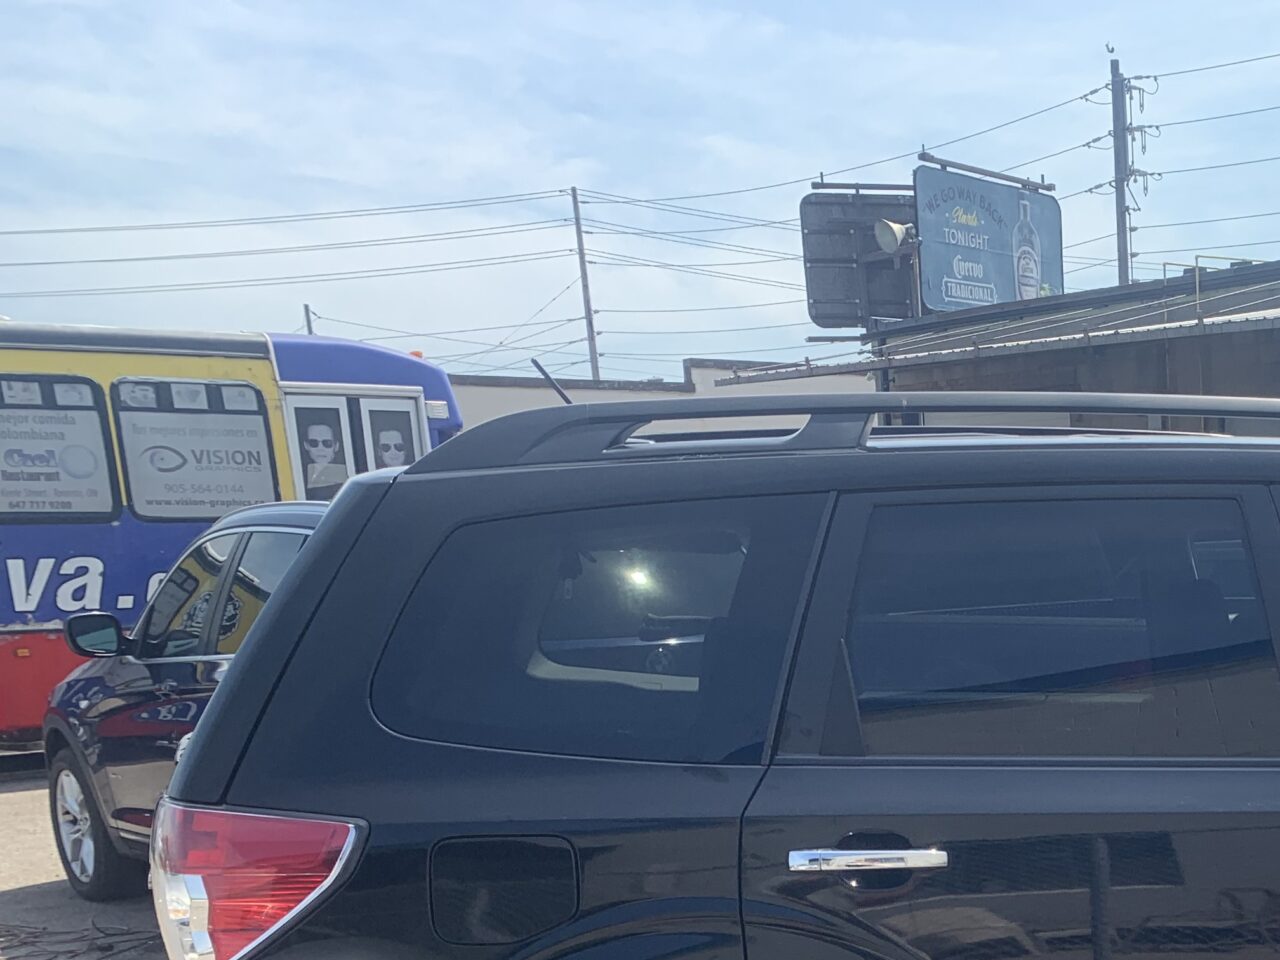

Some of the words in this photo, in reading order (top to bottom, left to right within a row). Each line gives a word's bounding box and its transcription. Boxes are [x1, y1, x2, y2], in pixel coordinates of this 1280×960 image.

[925, 193, 941, 215] WE
[940, 186, 956, 204] GO
[956, 185, 978, 206] WAY
[979, 194, 1004, 230] BACK
[943, 227, 989, 250] TONIGHT
[953, 254, 984, 279] Cuervo
[946, 282, 993, 301] TRADICIONAL
[190, 449, 262, 466] VISION
[194, 465, 262, 473] GRAPHICS
